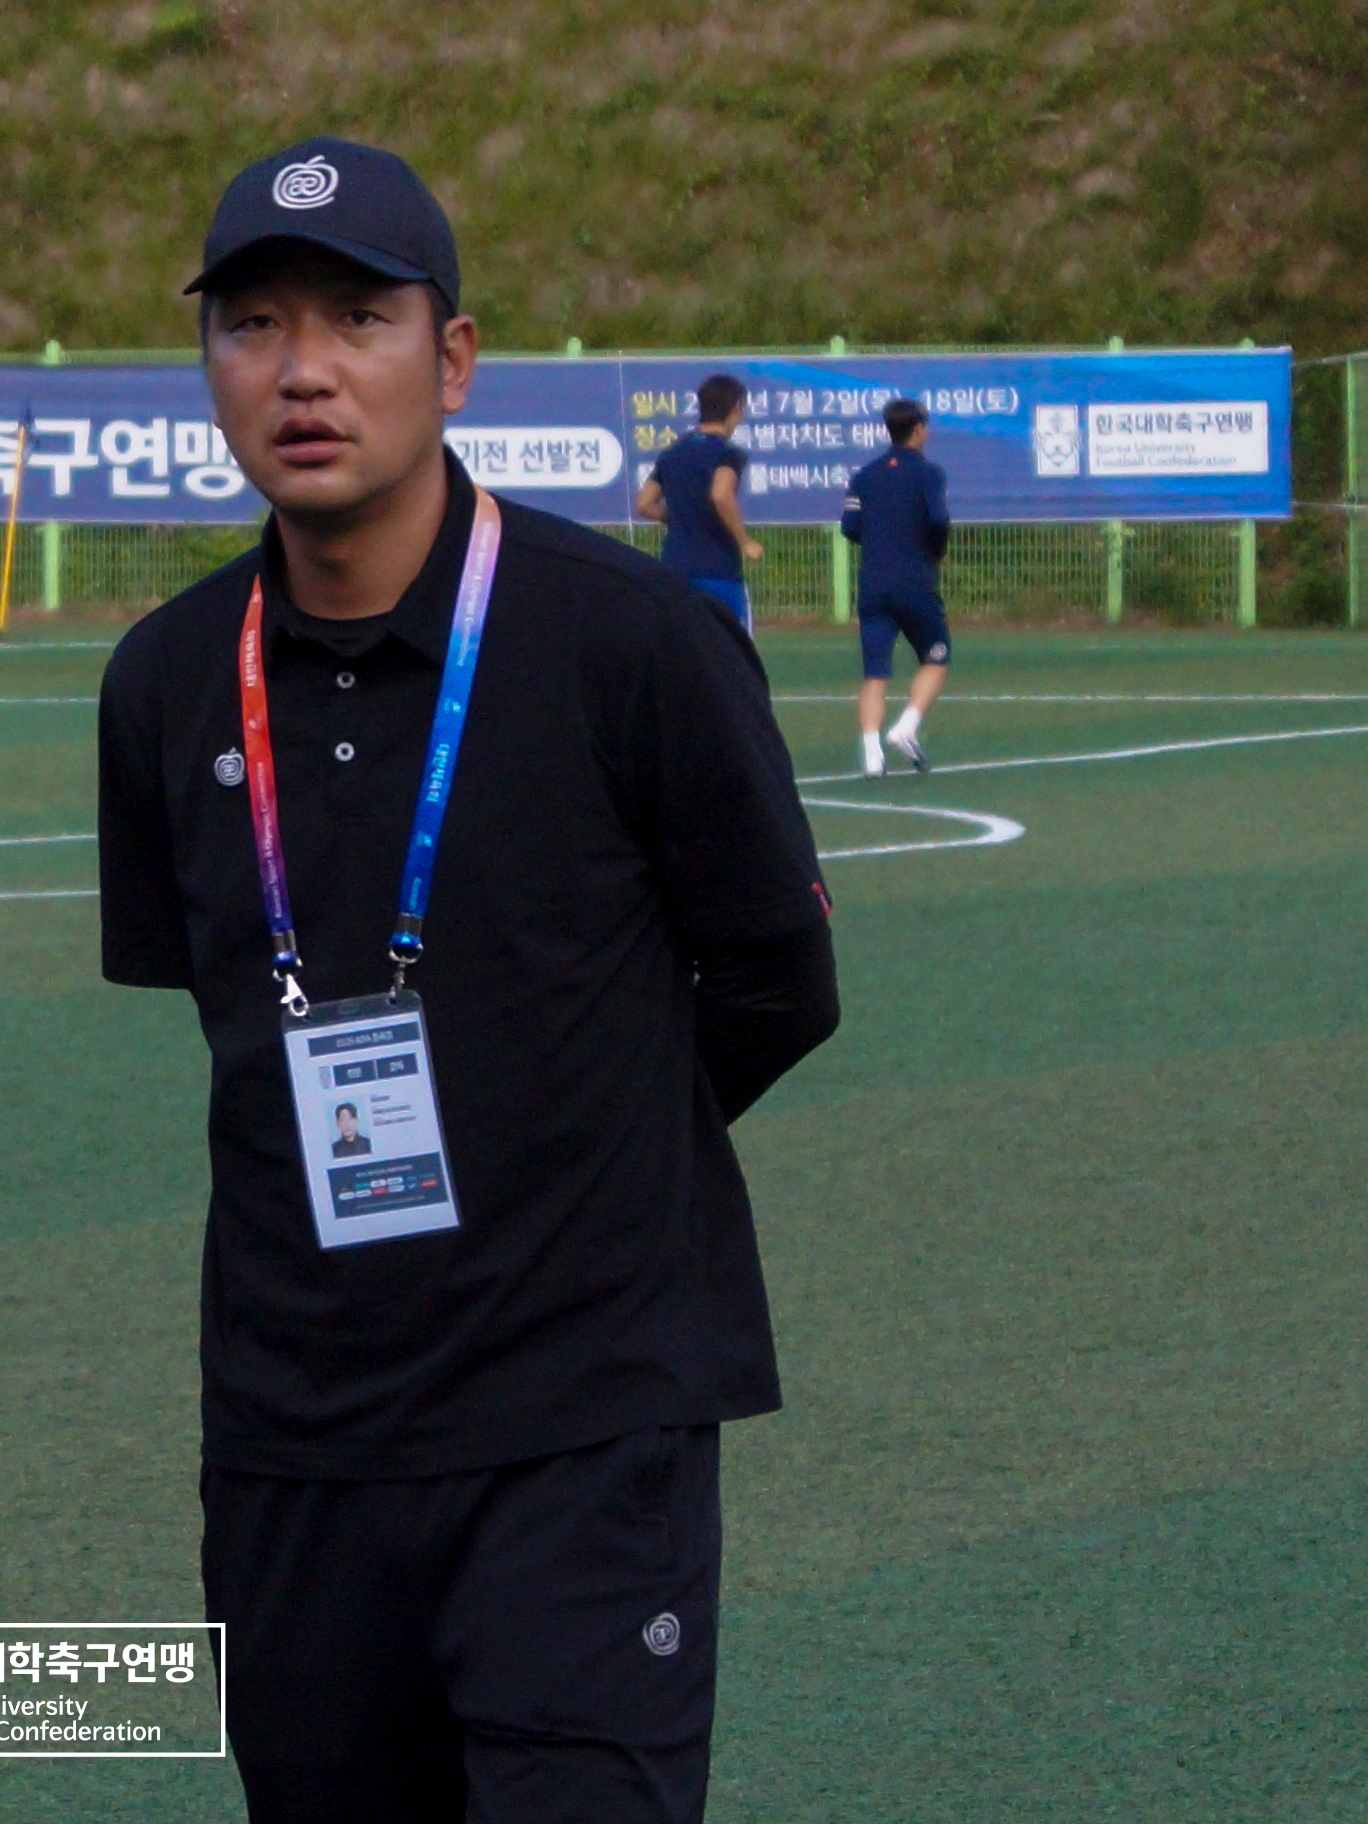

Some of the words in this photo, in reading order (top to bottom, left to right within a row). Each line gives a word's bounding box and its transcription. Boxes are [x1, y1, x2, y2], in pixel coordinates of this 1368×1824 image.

[633, 390, 676, 416] 일시
[776, 389, 813, 415] 7월
[1096, 411, 1253, 434] 한국대학축구연맹
[519, 439, 601, 473] 선발전
